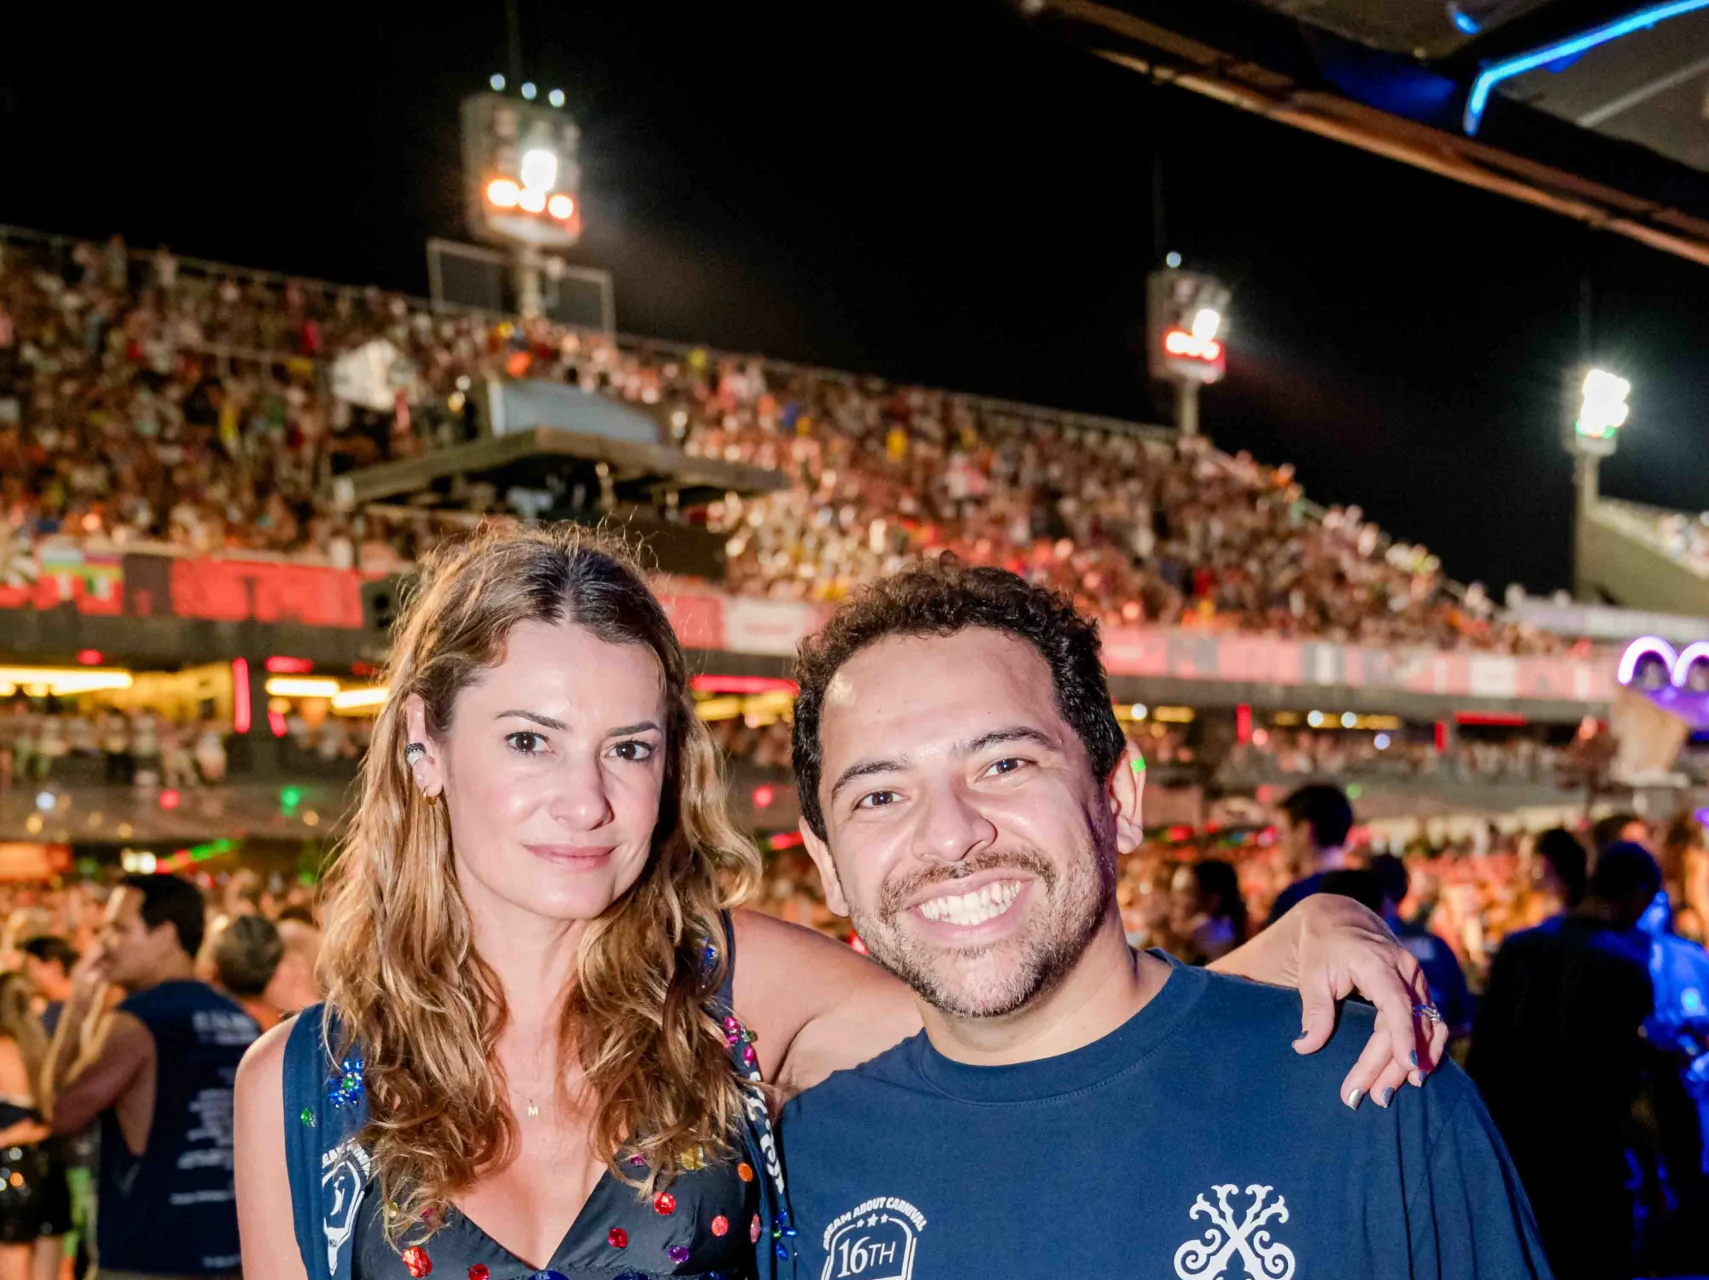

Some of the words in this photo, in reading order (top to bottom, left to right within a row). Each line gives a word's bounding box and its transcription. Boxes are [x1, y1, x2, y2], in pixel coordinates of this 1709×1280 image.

[853, 1196, 887, 1218] ABOUT
[886, 1197, 928, 1232] CARNIVAL
[837, 1236, 896, 1278] 16TH
